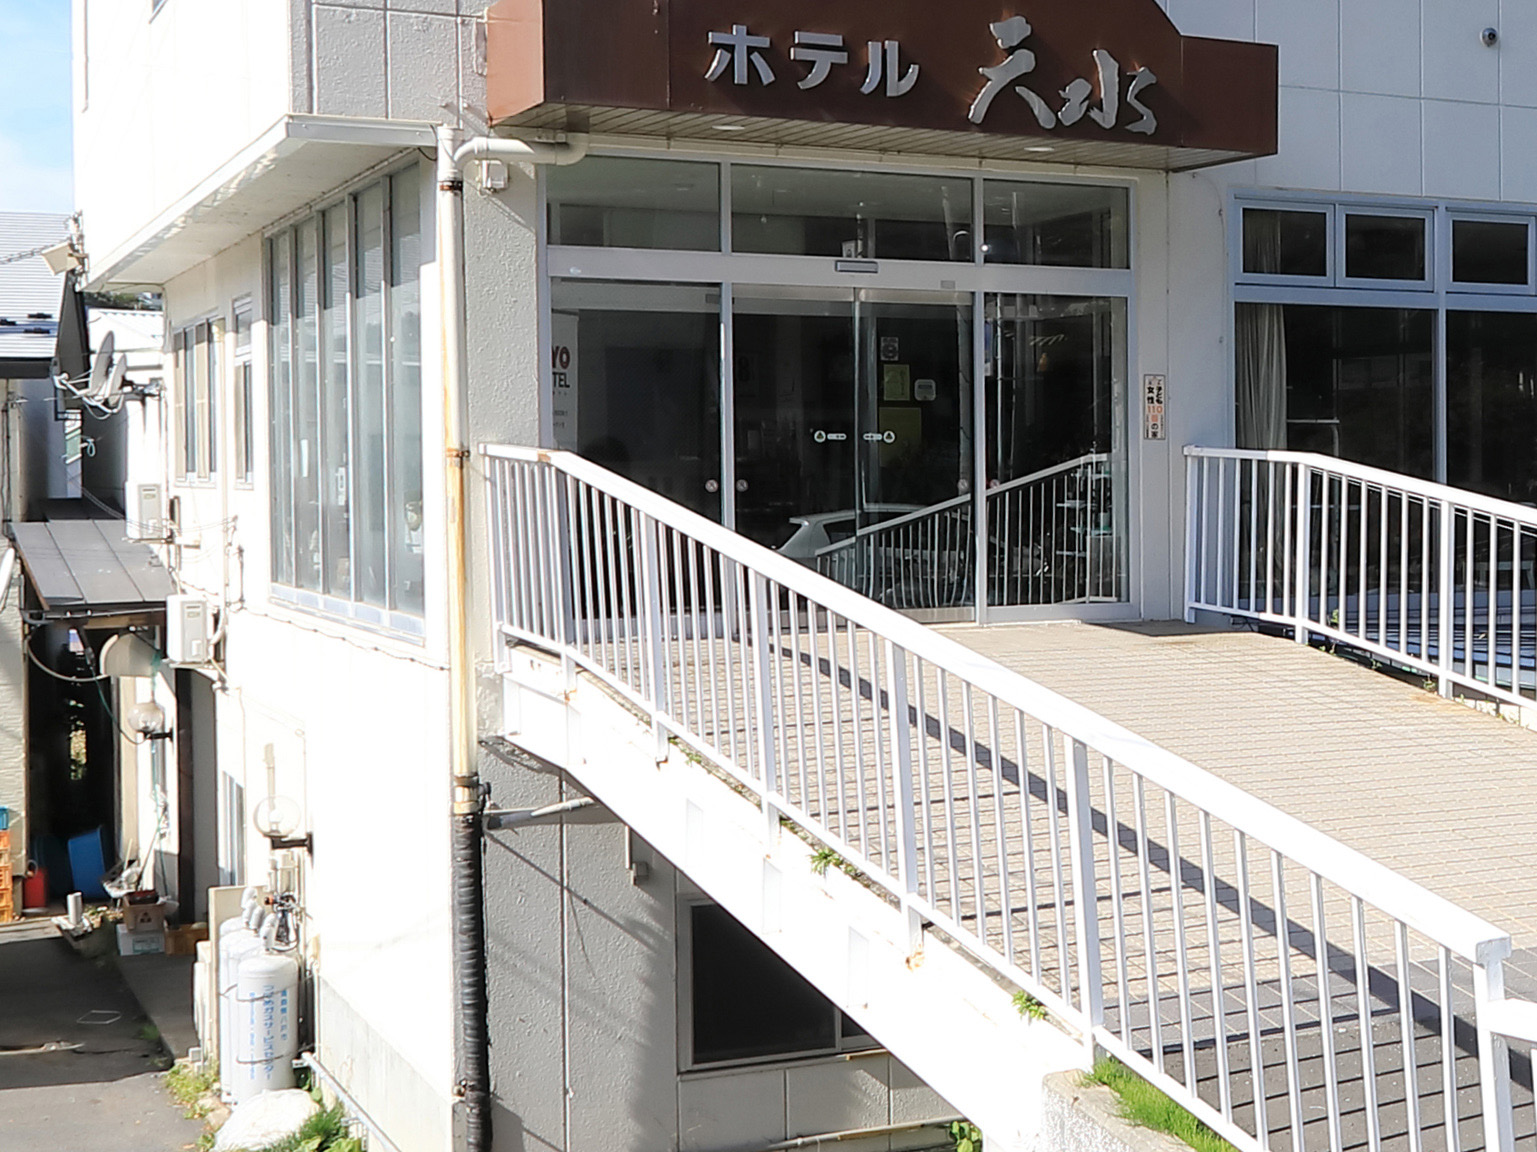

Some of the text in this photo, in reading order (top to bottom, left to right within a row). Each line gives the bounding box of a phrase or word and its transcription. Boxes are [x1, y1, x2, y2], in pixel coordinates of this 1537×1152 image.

[704, 24, 920, 98] ホテル
[552, 346, 570, 369] YO
[552, 372, 570, 388] TEL
